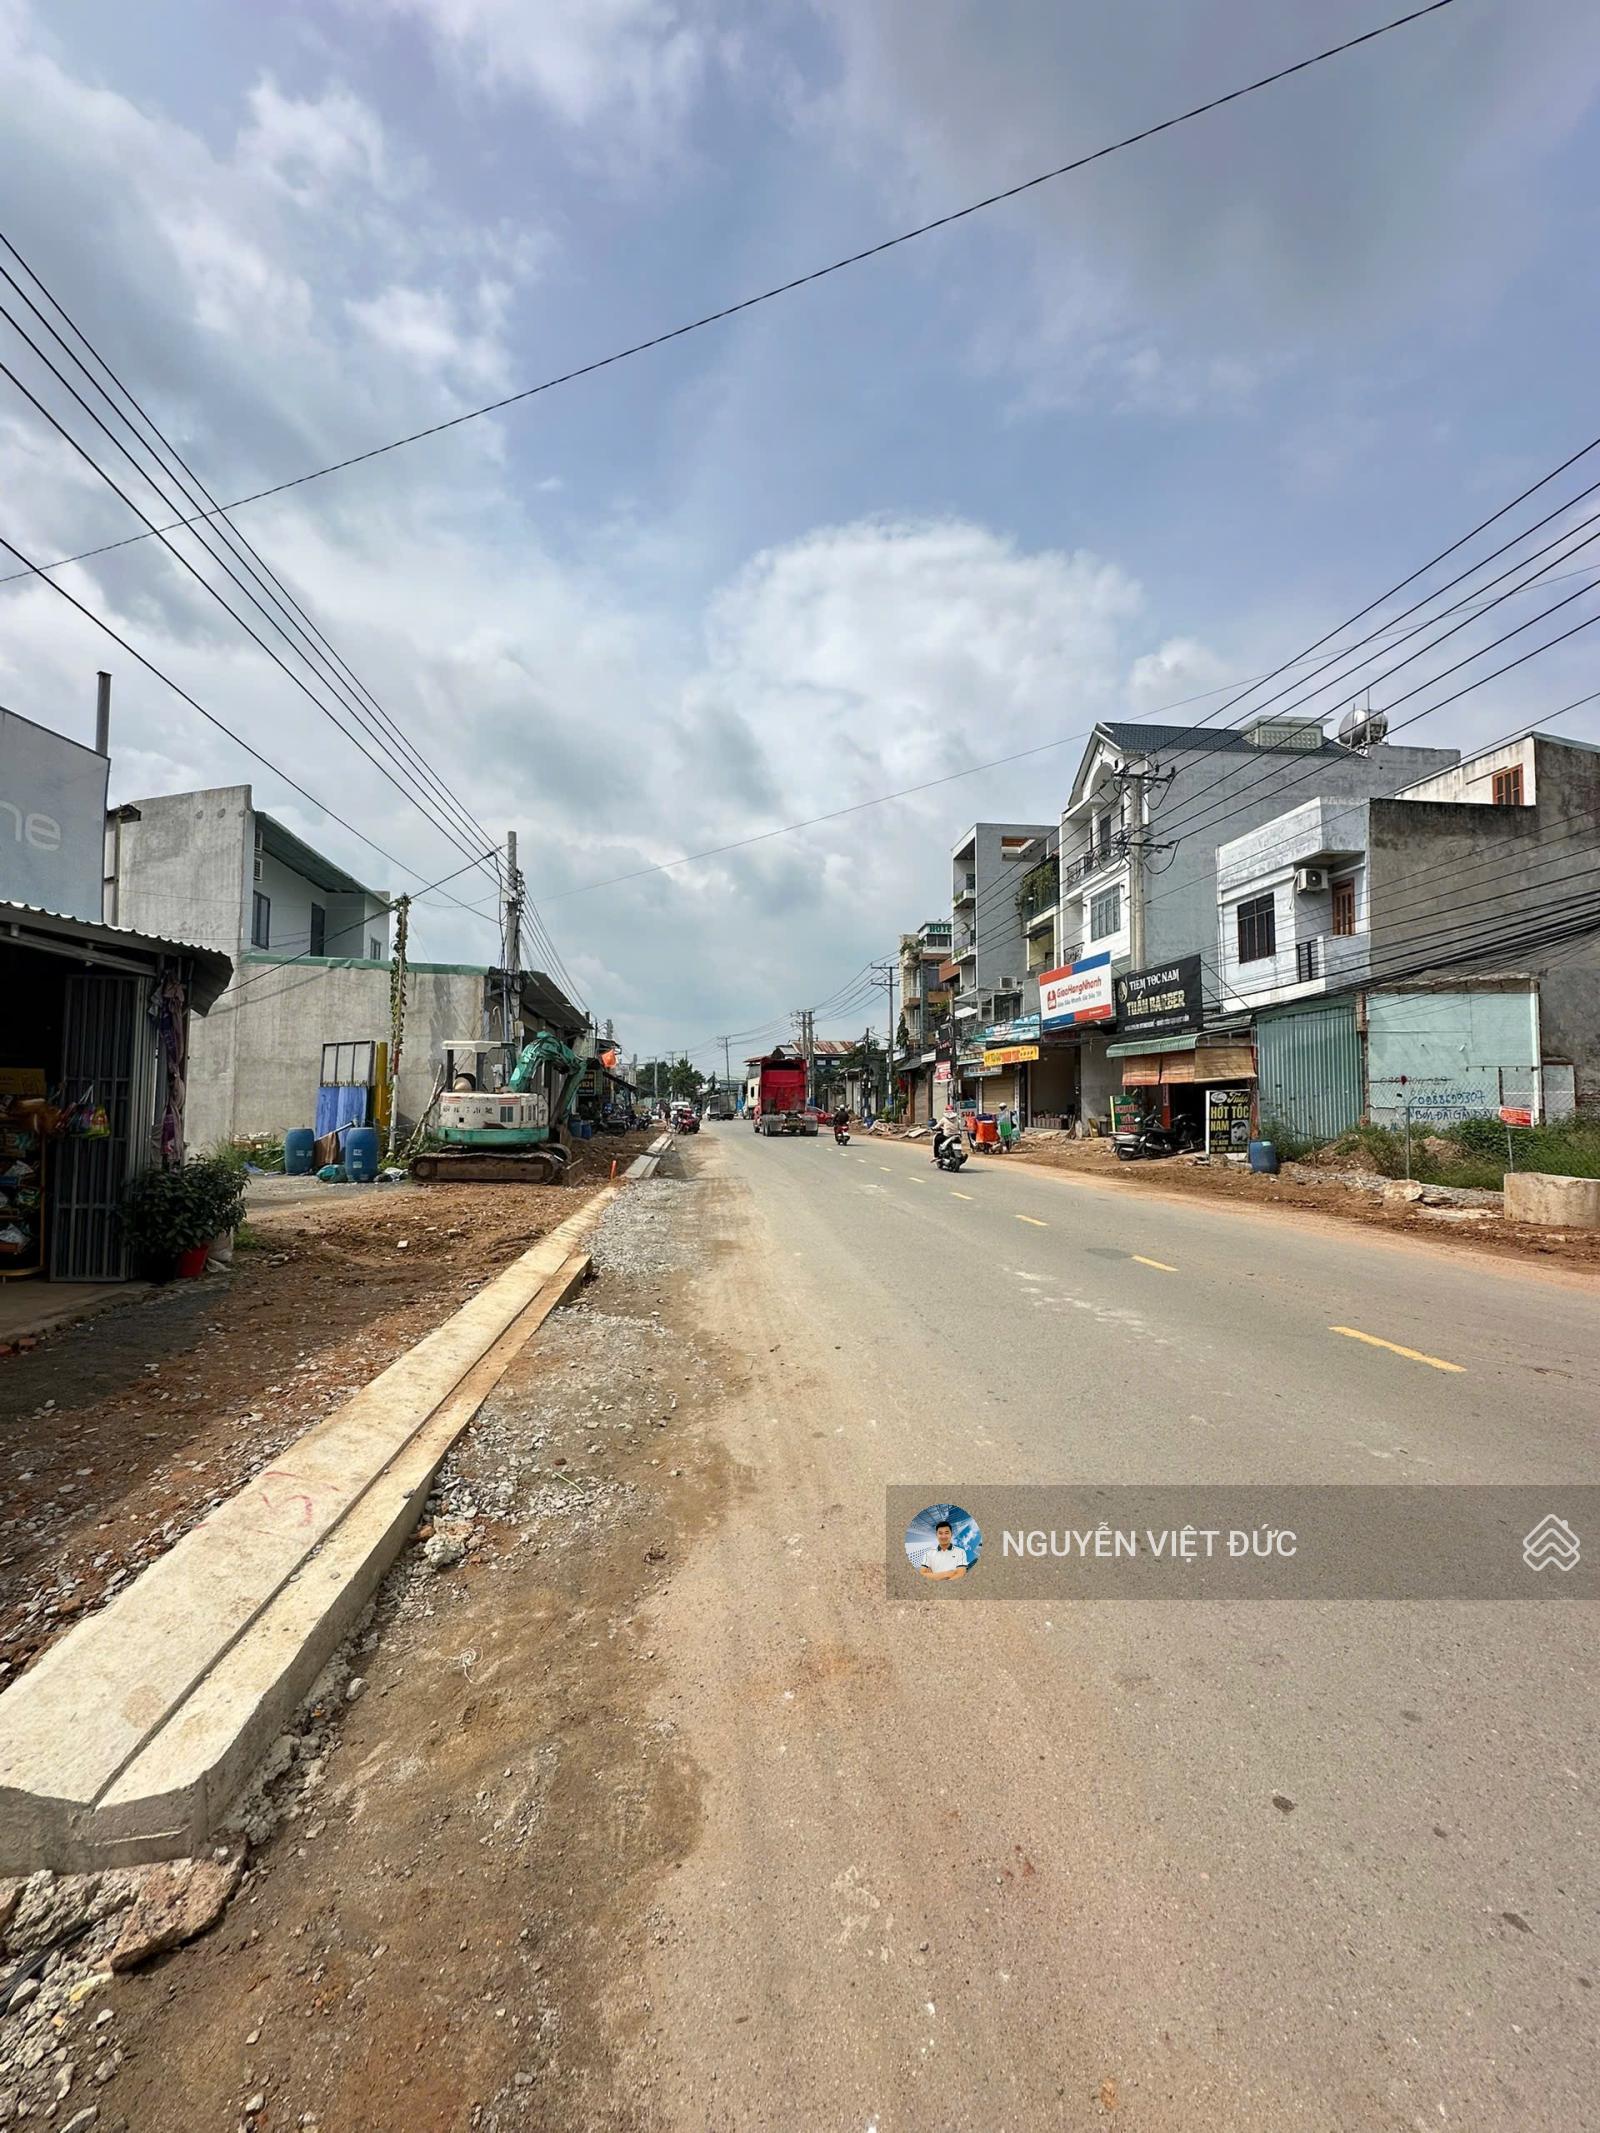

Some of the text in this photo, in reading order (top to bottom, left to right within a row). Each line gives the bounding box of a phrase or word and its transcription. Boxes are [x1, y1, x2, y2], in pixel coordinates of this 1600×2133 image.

[1161, 969, 1179, 983] NAM
[1231, 1103, 1249, 1119] TÓC
[1210, 1120, 1230, 1131] NAM
